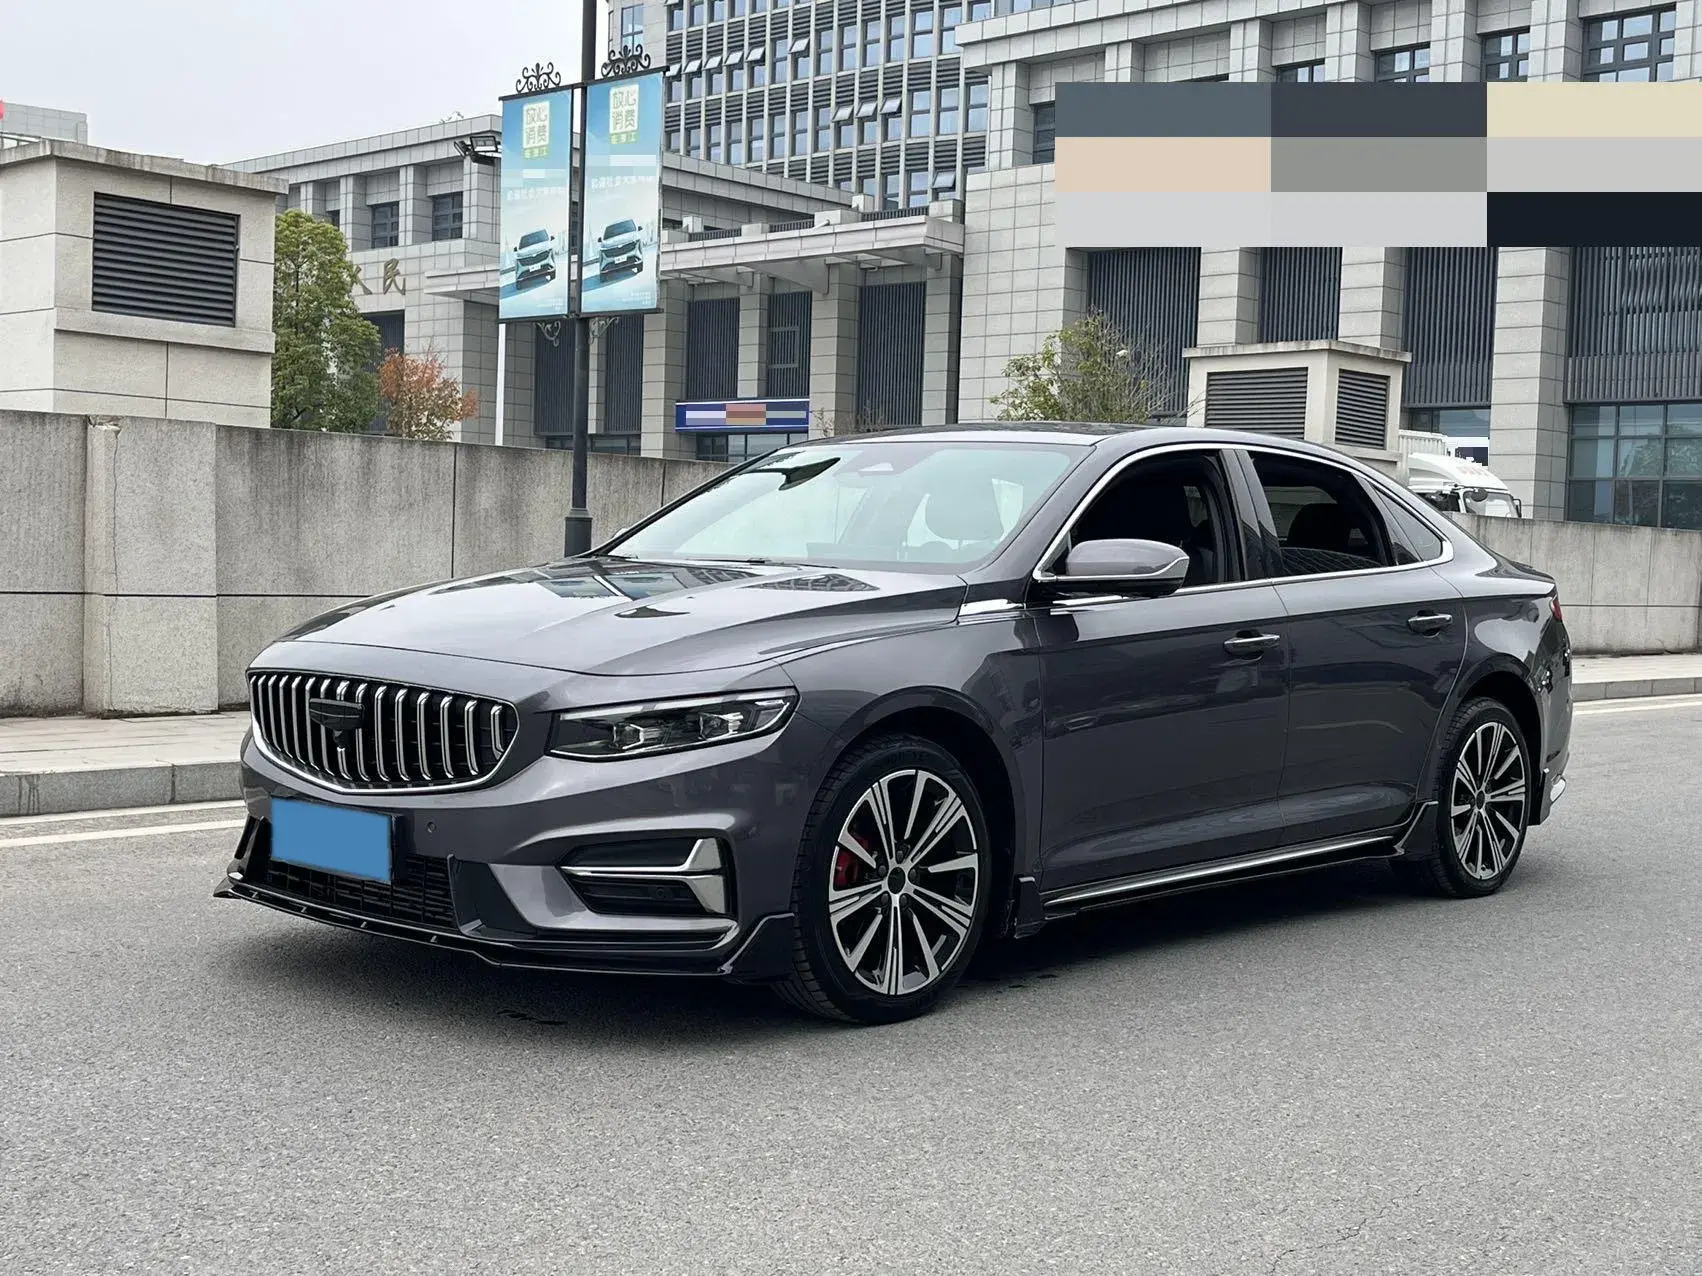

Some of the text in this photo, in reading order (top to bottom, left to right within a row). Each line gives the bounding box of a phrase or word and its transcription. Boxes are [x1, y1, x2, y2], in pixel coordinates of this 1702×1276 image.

[613, 90, 637, 109] 放心
[612, 109, 636, 130] 消费
[525, 124, 547, 145] 消费
